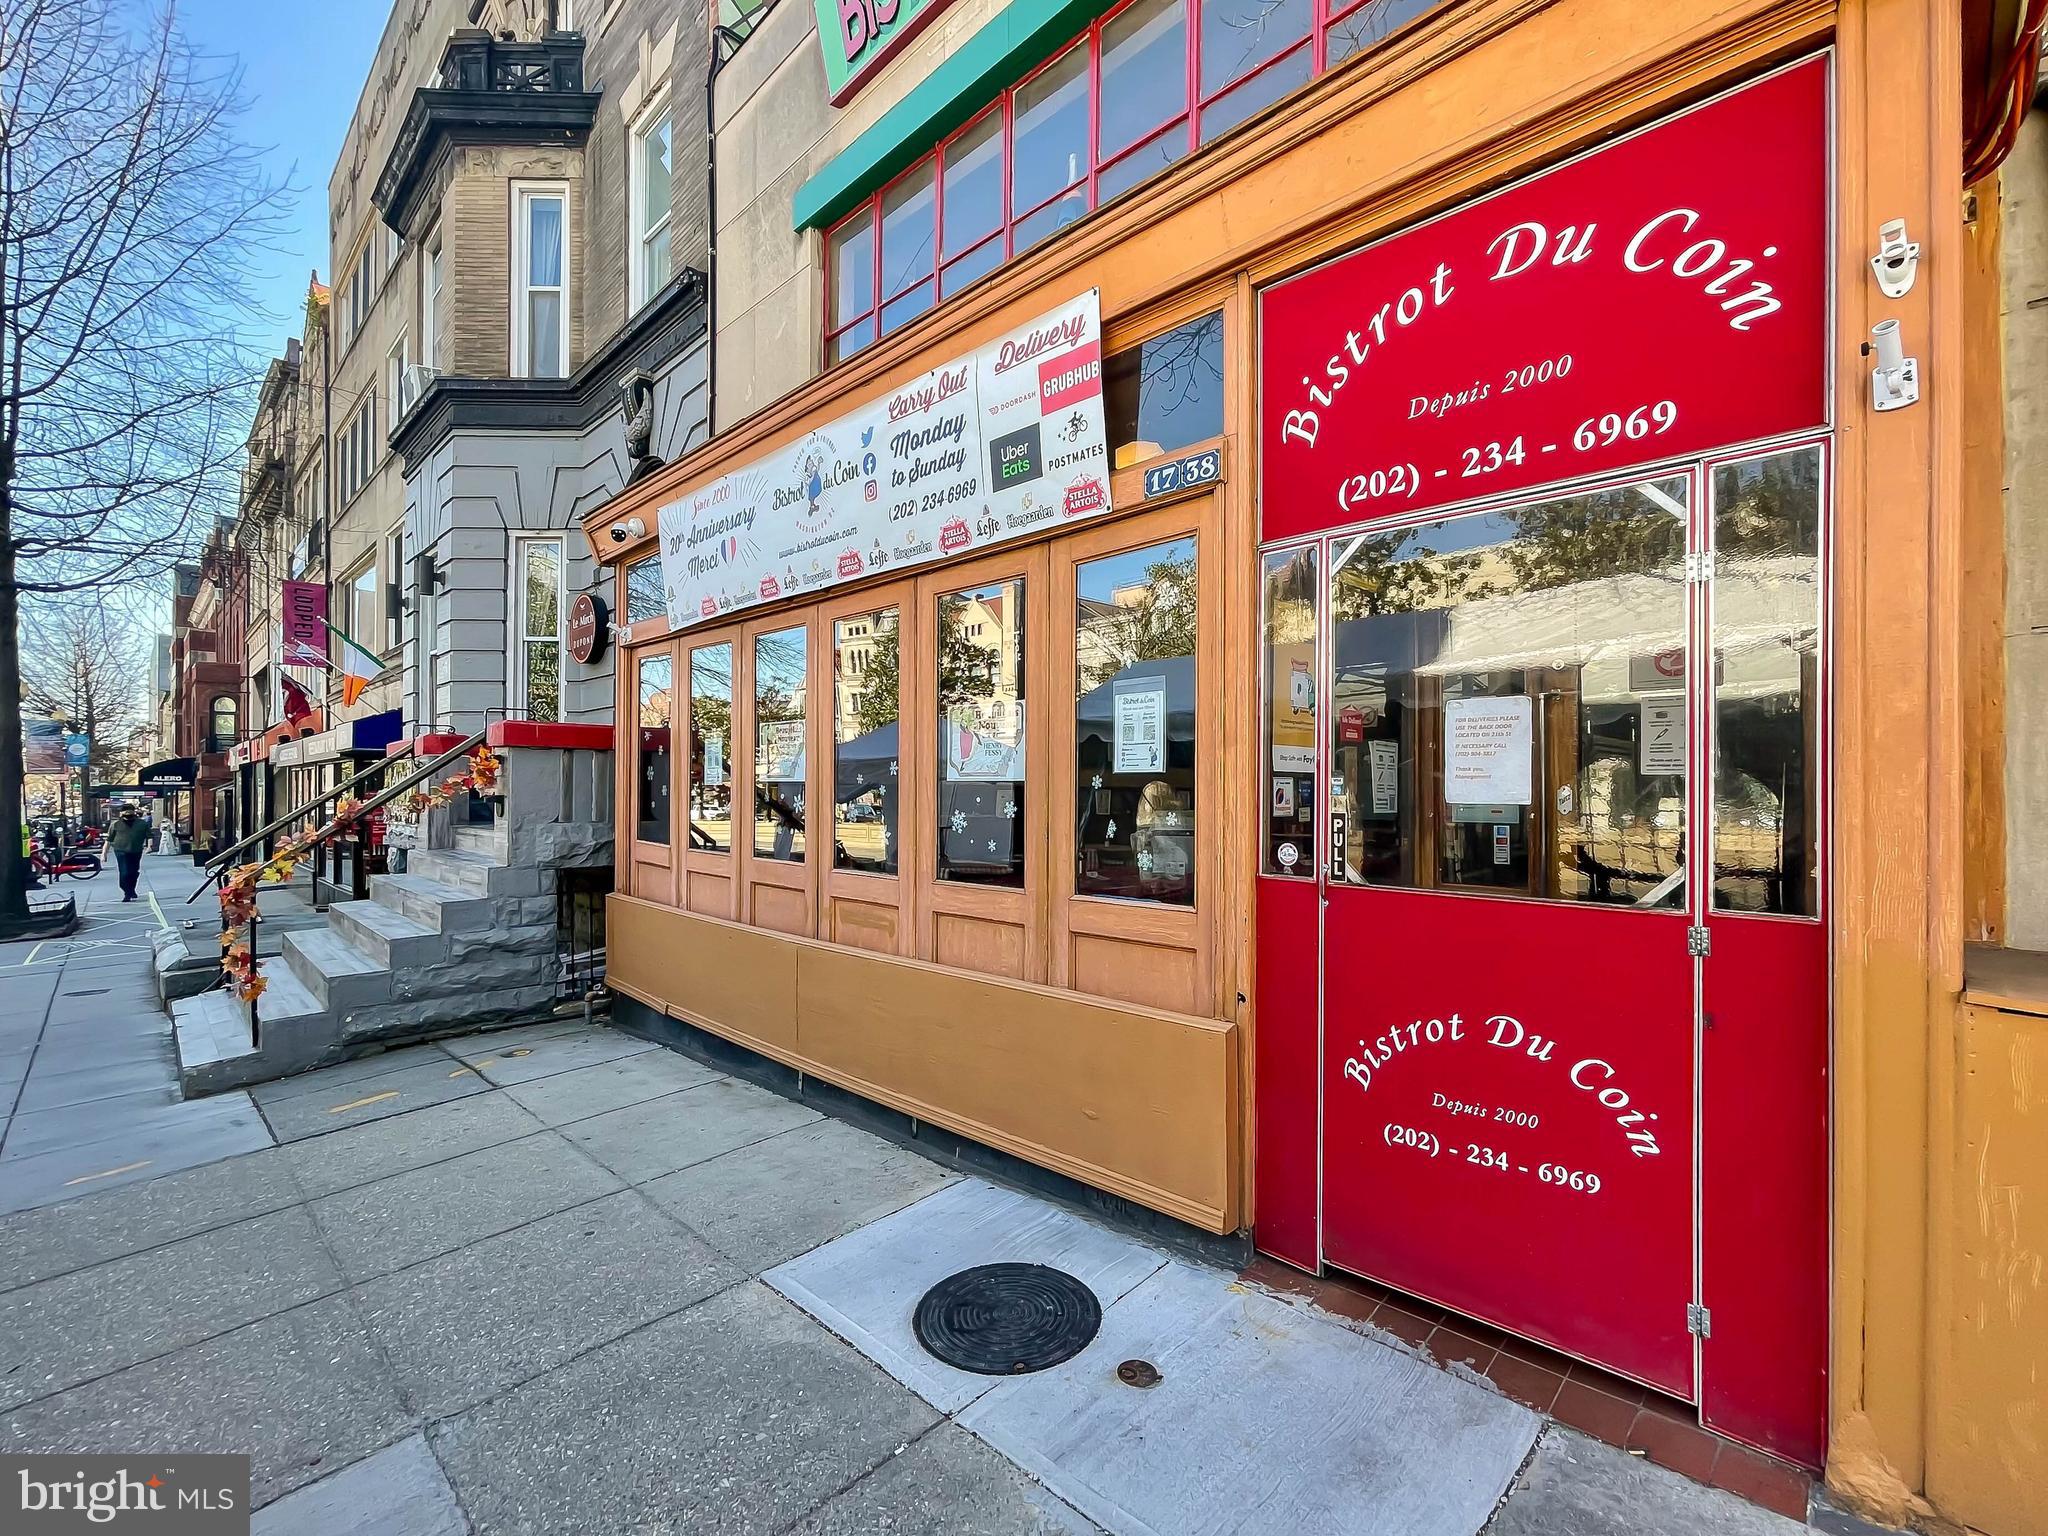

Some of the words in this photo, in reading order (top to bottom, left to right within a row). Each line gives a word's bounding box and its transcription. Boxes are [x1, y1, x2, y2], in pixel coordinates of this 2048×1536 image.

[995, 313, 1086, 372] Delivery
[1281, 261, 1456, 450] Bistrot
[1486, 221, 1598, 282] Du
[1623, 209, 1782, 331] Coin
[889, 386, 936, 420] Carry
[938, 365, 968, 400] Out
[1043, 360, 1100, 398] GRUBHUB
[1407, 380, 1491, 420] Depuis
[1500, 354, 1573, 394] 2000
[1000, 391, 1037, 411] DOORDASH
[890, 413, 967, 459] Monday
[1001, 442, 1029, 462] Uber
[892, 468, 906, 487] to
[909, 448, 967, 487] Sunday
[1002, 459, 1030, 479] Eats
[1048, 443, 1104, 472] POSTMATES
[1338, 462, 1421, 511] (202)
[1461, 435, 1525, 478] 234
[1573, 401, 1678, 452] 6969
[692, 496, 710, 520] Since
[712, 484, 731, 505] 2000
[772, 481, 805, 511] Bistrot
[823, 472, 834, 490] du
[834, 459, 860, 486] Coin
[1069, 486, 1098, 501] STELLA
[888, 499, 918, 523] (202)
[1006, 505, 1054, 529] Hoegaarden
[1070, 497, 1099, 510] ARTOIS
[687, 506, 756, 549] Anniversary
[944, 528, 966, 539] STELLA
[945, 535, 966, 547] ARTOIS
[976, 518, 1000, 540] Leffe
[688, 547, 719, 580] Merci
[841, 557, 858, 567] STELLA
[869, 550, 889, 569] Leffe
[893, 541, 932, 560] Hoegaarden
[841, 564, 859, 574] ARTOIS
[294, 588, 313, 638] LOOPED
[1333, 818, 1344, 876] PULL
[1344, 1013, 1465, 1091] Bistrot
[1485, 1015, 1557, 1061] Du
[1569, 1059, 1661, 1158] Coin
[1432, 1092, 1488, 1118] Depuis
[1494, 1107, 1539, 1129] 2000
[1383, 1123, 1440, 1158] (202)
[1467, 1144, 1509, 1172] 234
[1538, 1163, 1601, 1194] 6969
